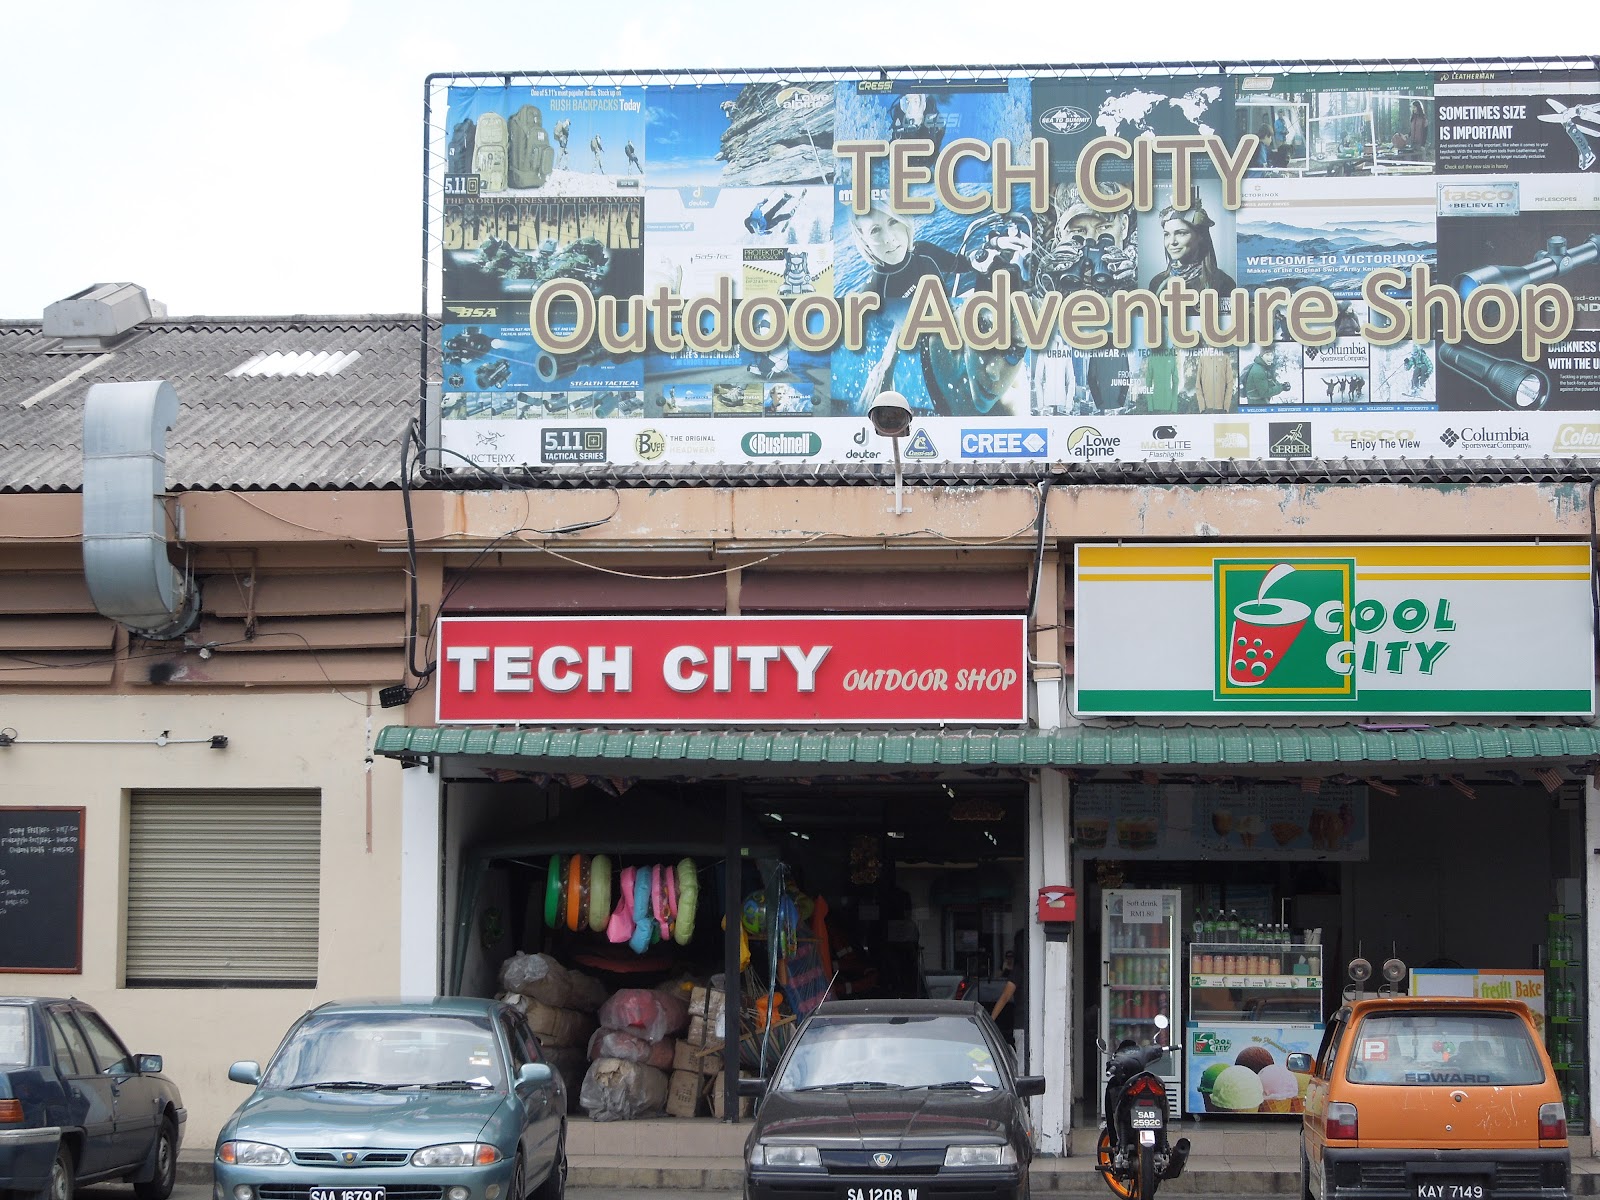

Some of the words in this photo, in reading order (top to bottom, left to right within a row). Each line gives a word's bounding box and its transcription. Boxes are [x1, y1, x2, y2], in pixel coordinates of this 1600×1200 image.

[858, 81, 894, 90] CRESSI
[550, 99, 571, 111] RUSH
[573, 99, 618, 111] BACKPACKS
[619, 99, 641, 113] Today
[1439, 106, 1501, 120] SOMETIMES
[1503, 105, 1526, 119] SIZE
[1440, 126, 1450, 140] IS
[1453, 126, 1513, 139] IMPORTANT
[834, 137, 1049, 214] TECH
[1076, 134, 1260, 212] CITY
[445, 177, 466, 195] 5.11
[838, 189, 890, 200] mes
[1443, 189, 1514, 201] tasco
[443, 204, 641, 250] BLACKHAWK!
[1247, 256, 1315, 266] WELCOME
[1320, 255, 1337, 264] TO
[1342, 254, 1425, 264] VICTORINOX
[456, 306, 498, 318] BSA
[530, 272, 881, 355] Outdoor
[898, 268, 1339, 352] Adventure
[1361, 263, 1575, 362] Shop
[1047, 350, 1072, 358] URBAN
[1074, 349, 1119, 358] OUTERWEAR
[1138, 349, 1177, 357] TECHNICAL
[1319, 344, 1367, 355] Columbia
[1548, 358, 1571, 370] WITH
[1574, 358, 1591, 369] THE
[545, 431, 583, 451] 5.11
[1086, 434, 1121, 447] Lowe
[1331, 427, 1415, 442] tasco
[1461, 427, 1530, 442] Columbia
[757, 433, 810, 454] Bushnell
[962, 433, 1022, 453] CREE
[1141, 440, 1192, 449] MAG-LITE
[1271, 444, 1311, 455] GERBER
[1350, 438, 1376, 451] Enjoy
[1380, 438, 1396, 449] The
[1399, 438, 1421, 449] View
[1461, 442, 1496, 450] Sportswear
[1496, 442, 1529, 451] Company
[580, 452, 604, 460] SERIES
[846, 449, 881, 459] deuter
[1074, 446, 1115, 459] alpine
[1314, 598, 1457, 635] COOL
[1325, 640, 1451, 676] CITY
[446, 645, 633, 694] TECH
[662, 645, 834, 693] CITY
[843, 669, 949, 692] OUTDOOR
[954, 668, 1017, 692] SHOP
[1515, 980, 1542, 998] Bake
[1365, 1042, 1385, 1060] P
[1405, 1072, 1490, 1083] EDWARD
[1137, 1111, 1155, 1119] SAB
[847, 1188, 865, 1200] SA
[868, 1188, 902, 1200] 1208
[908, 1188, 918, 1200] W
[1418, 1185, 1444, 1199] KAY
[1449, 1185, 1483, 1199] 7149
